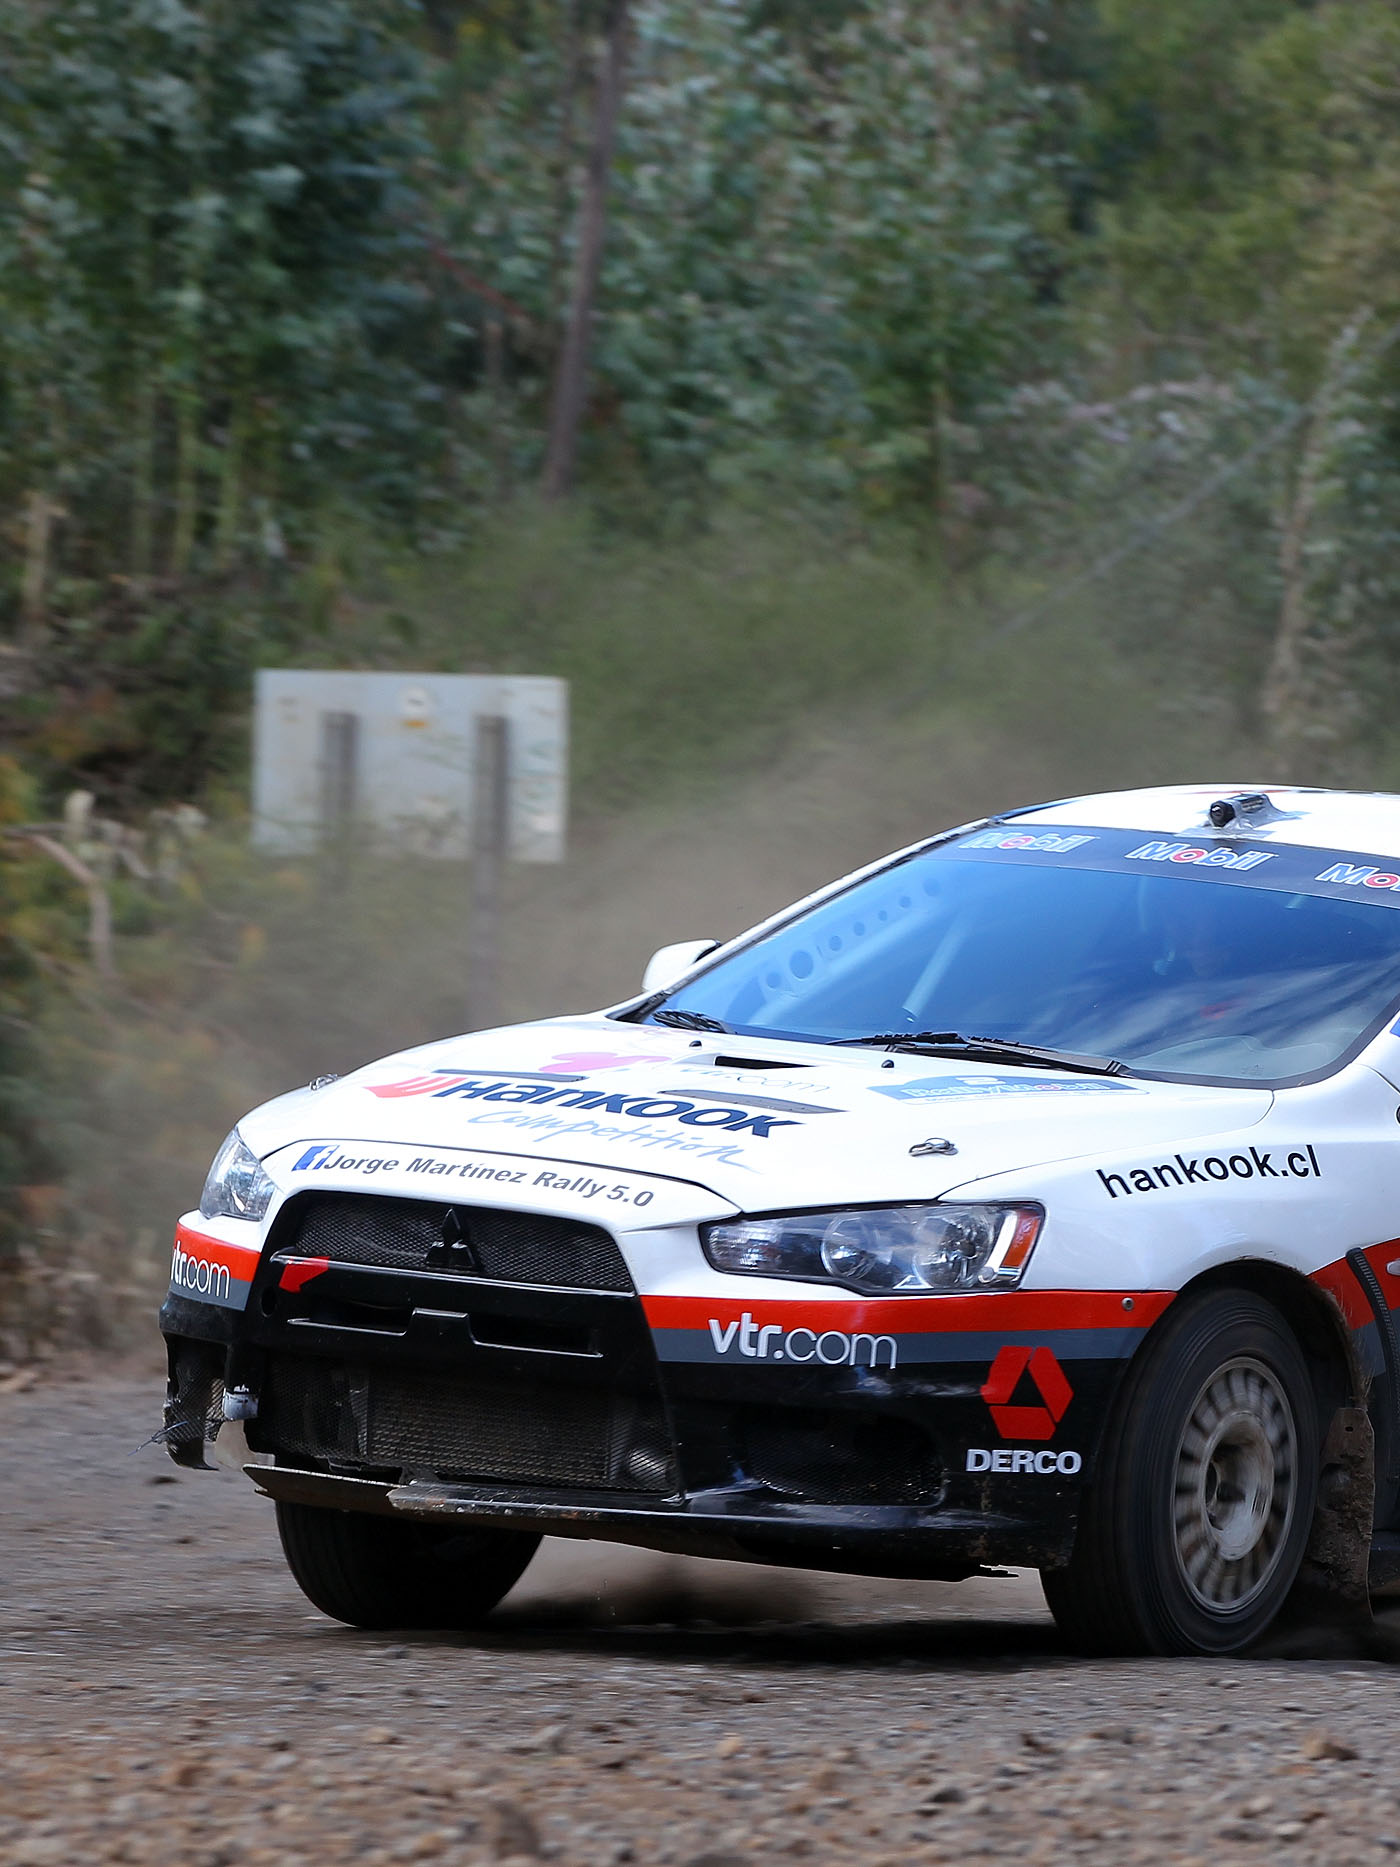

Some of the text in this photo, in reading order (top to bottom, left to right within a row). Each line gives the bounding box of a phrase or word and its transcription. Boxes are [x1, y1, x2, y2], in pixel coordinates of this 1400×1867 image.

[1124, 841, 1276, 872] Mobil
[324, 1154, 400, 1174] Jorge
[532, 1171, 608, 1199] Rally
[607, 1184, 655, 1208] 5.0
[1096, 1144, 1323, 1199] hankook.cl
[707, 1311, 898, 1370] vtr.com
[965, 1448, 1083, 1475] DERCO
